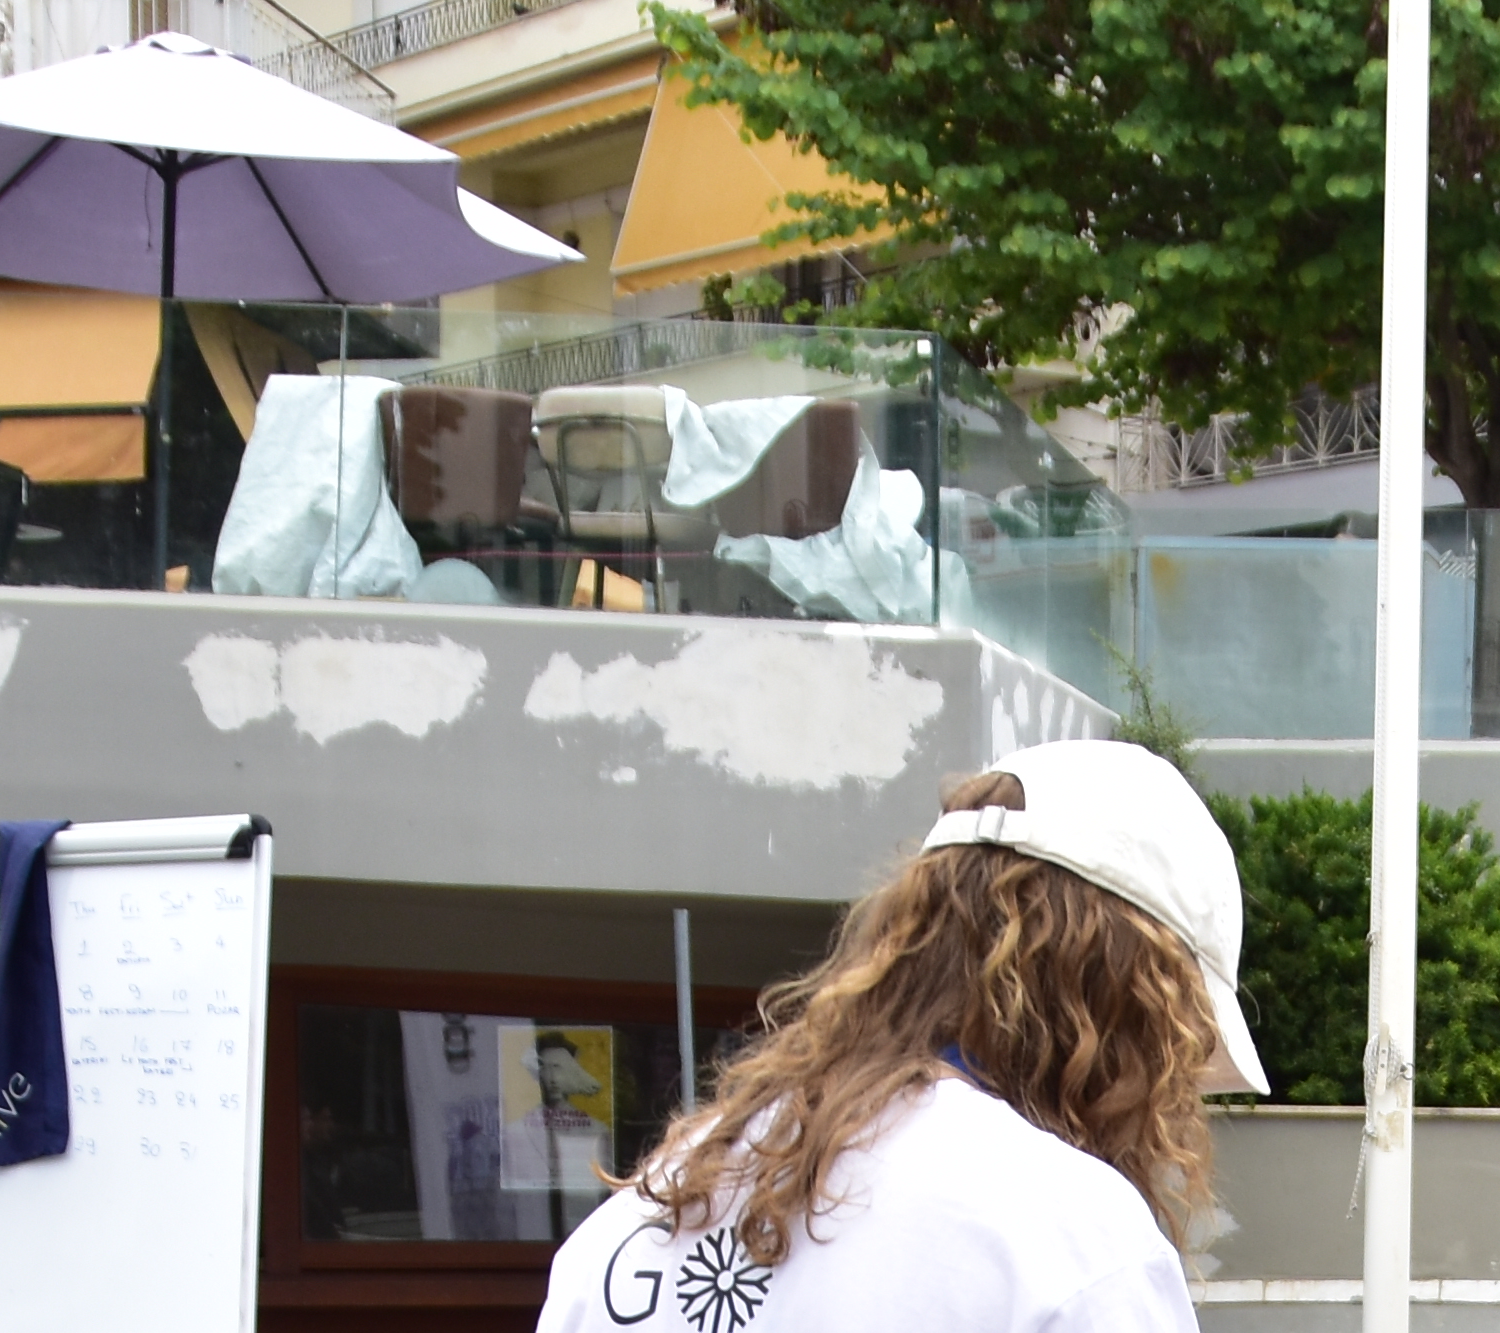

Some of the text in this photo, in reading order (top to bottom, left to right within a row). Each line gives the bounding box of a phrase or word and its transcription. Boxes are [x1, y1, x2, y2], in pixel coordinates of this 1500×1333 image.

[214, 887, 245, 906] Sun
[78, 935, 226, 957] 1 2 3 4
[78, 983, 94, 1001] 8
[128, 983, 142, 1000] 9
[171, 989, 188, 1001] 10
[217, 1039, 235, 1056] 18
[136, 1086, 157, 1106] 23
[175, 1090, 197, 1108] 24
[218, 1092, 241, 1110] 25
[139, 1135, 162, 1157] 30
